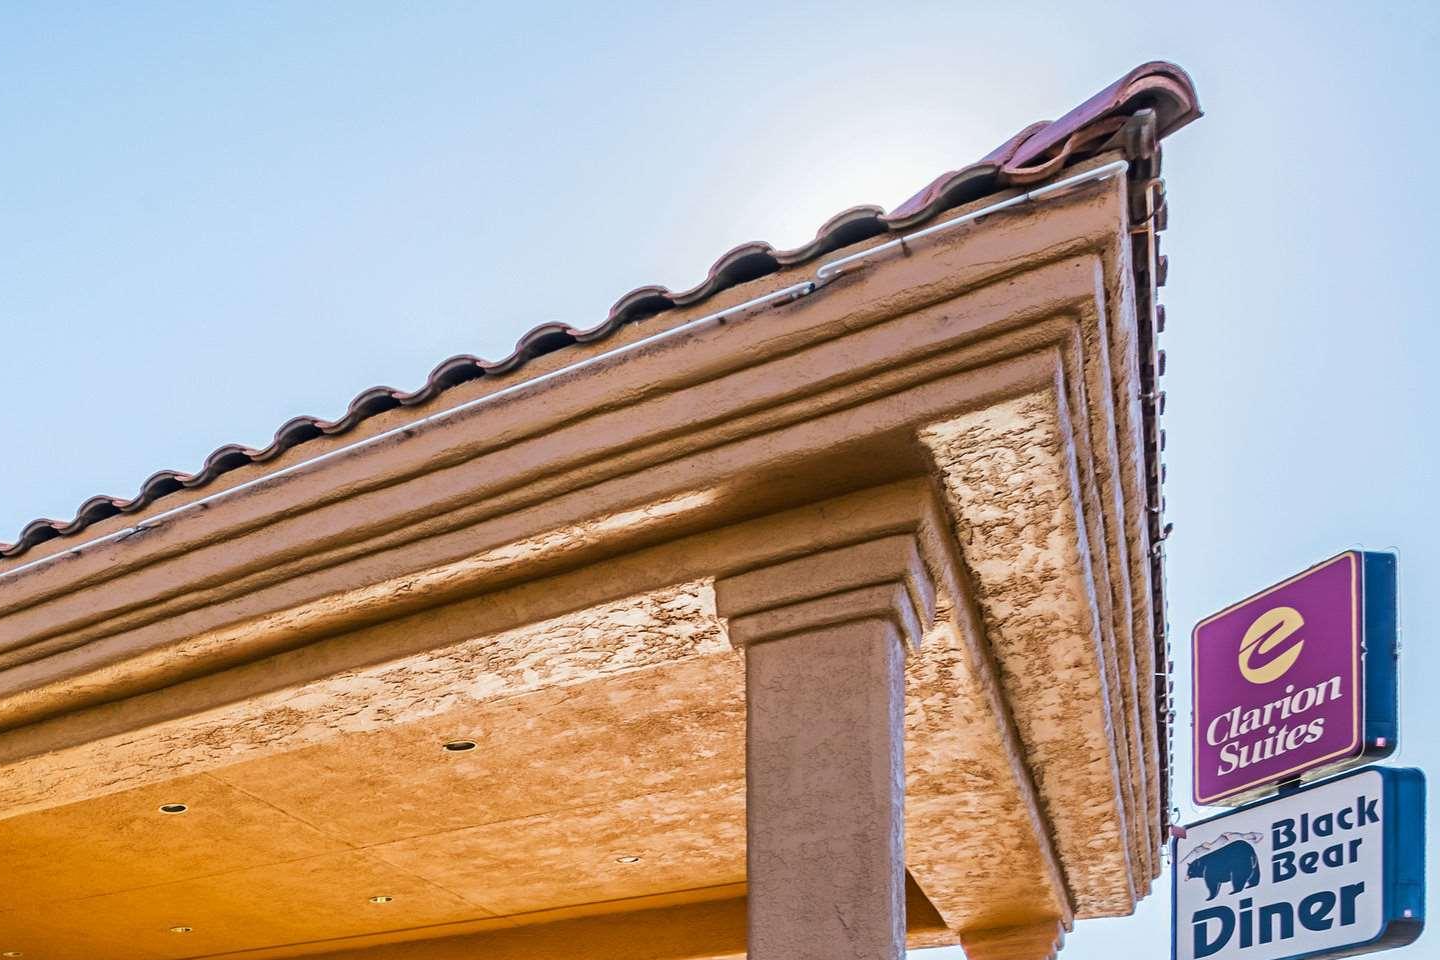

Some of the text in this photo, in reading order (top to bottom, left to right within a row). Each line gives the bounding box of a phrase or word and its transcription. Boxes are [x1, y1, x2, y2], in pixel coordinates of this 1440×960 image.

[1206, 676, 1343, 746] Clarion
[1217, 718, 1325, 776] Suites
[1271, 795, 1380, 851] Black
[1271, 838, 1363, 884] Bear
[1192, 881, 1365, 959] Diner
